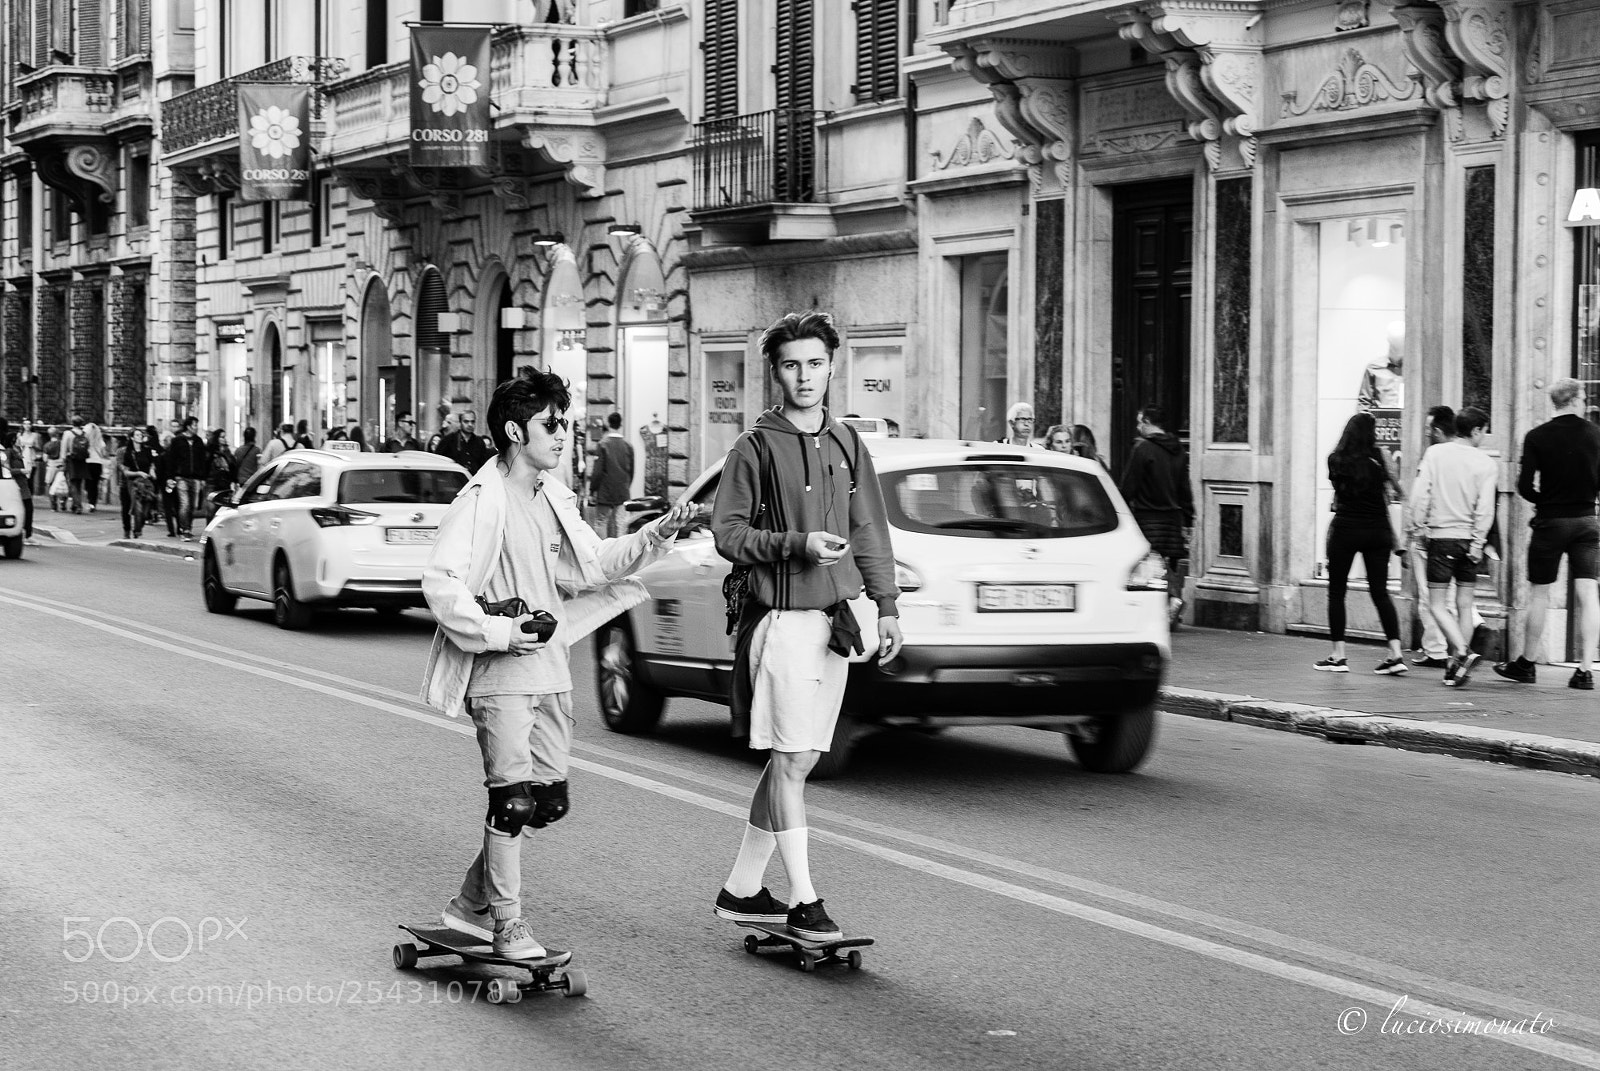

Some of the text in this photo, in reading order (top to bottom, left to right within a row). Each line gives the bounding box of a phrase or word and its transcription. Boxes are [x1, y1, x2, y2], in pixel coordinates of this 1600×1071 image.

[412, 129, 489, 142] CORSO 281
[243, 168, 290, 180] CORSO
